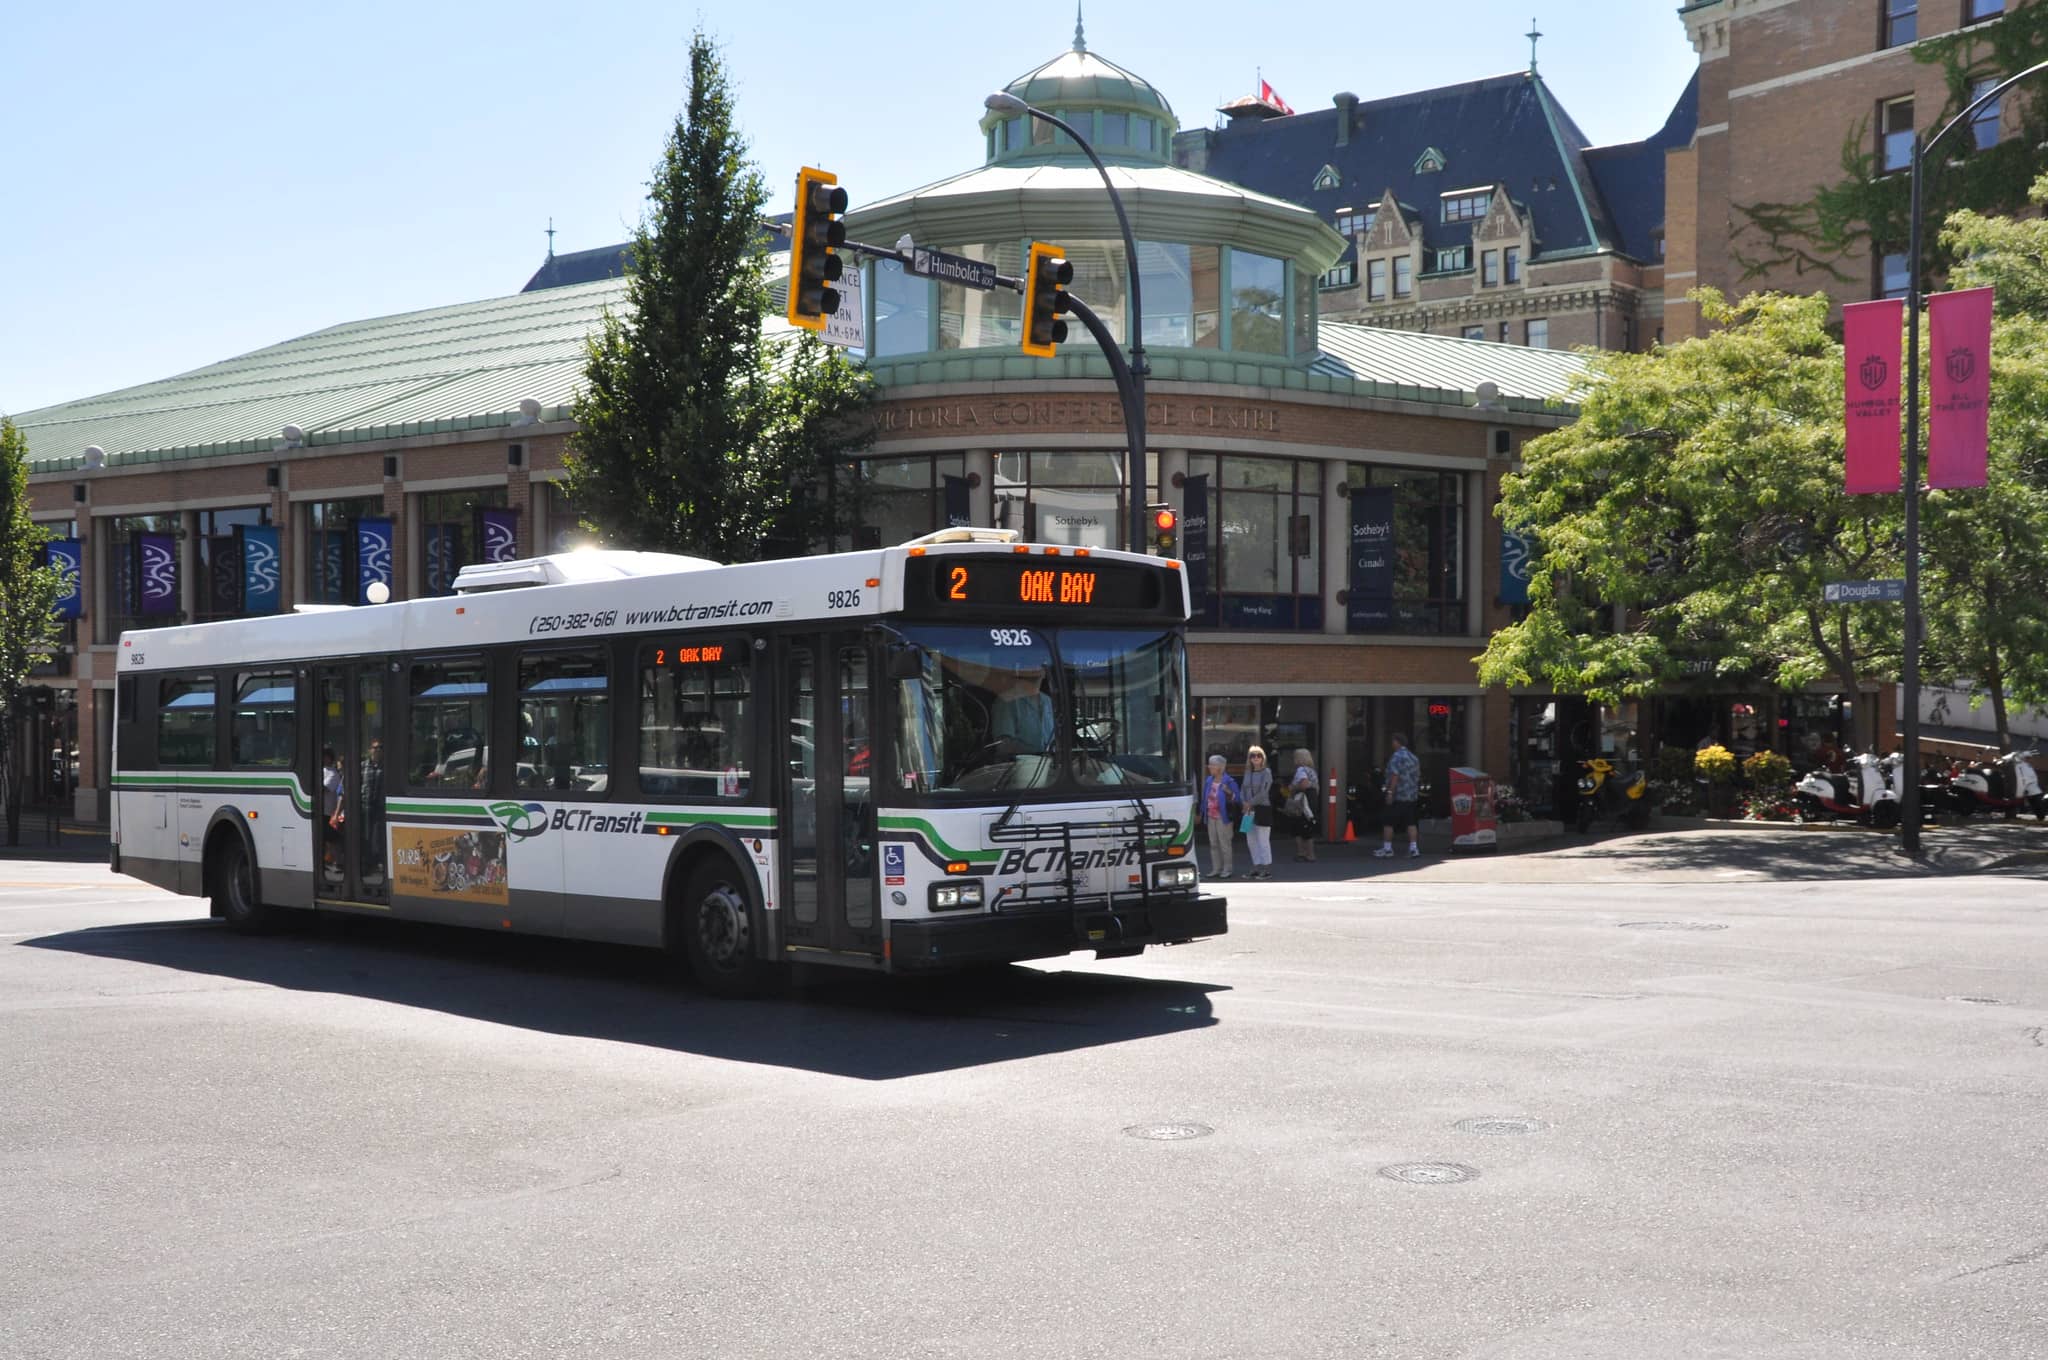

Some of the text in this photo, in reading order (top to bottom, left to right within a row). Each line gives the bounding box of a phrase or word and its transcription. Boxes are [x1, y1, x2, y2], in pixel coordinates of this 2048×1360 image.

[931, 255, 980, 283] Humboldt
[992, 402, 1178, 426] CONFERECE
[1191, 405, 1280, 432] CENTRE
[1056, 514, 1098, 527] Sotheby's
[1353, 521, 1390, 537] Sotheby's
[950, 567, 1096, 604] 2 OAK BAY
[1841, 583, 1881, 598] Douglas
[828, 589, 861, 609] 9826
[625, 599, 773, 624] www.bctransit.com
[990, 628, 1032, 646] 9826
[656, 646, 722, 664] 2 OAK BAY
[550, 808, 642, 834] BCTransit
[999, 842, 1139, 876] BCTransit
